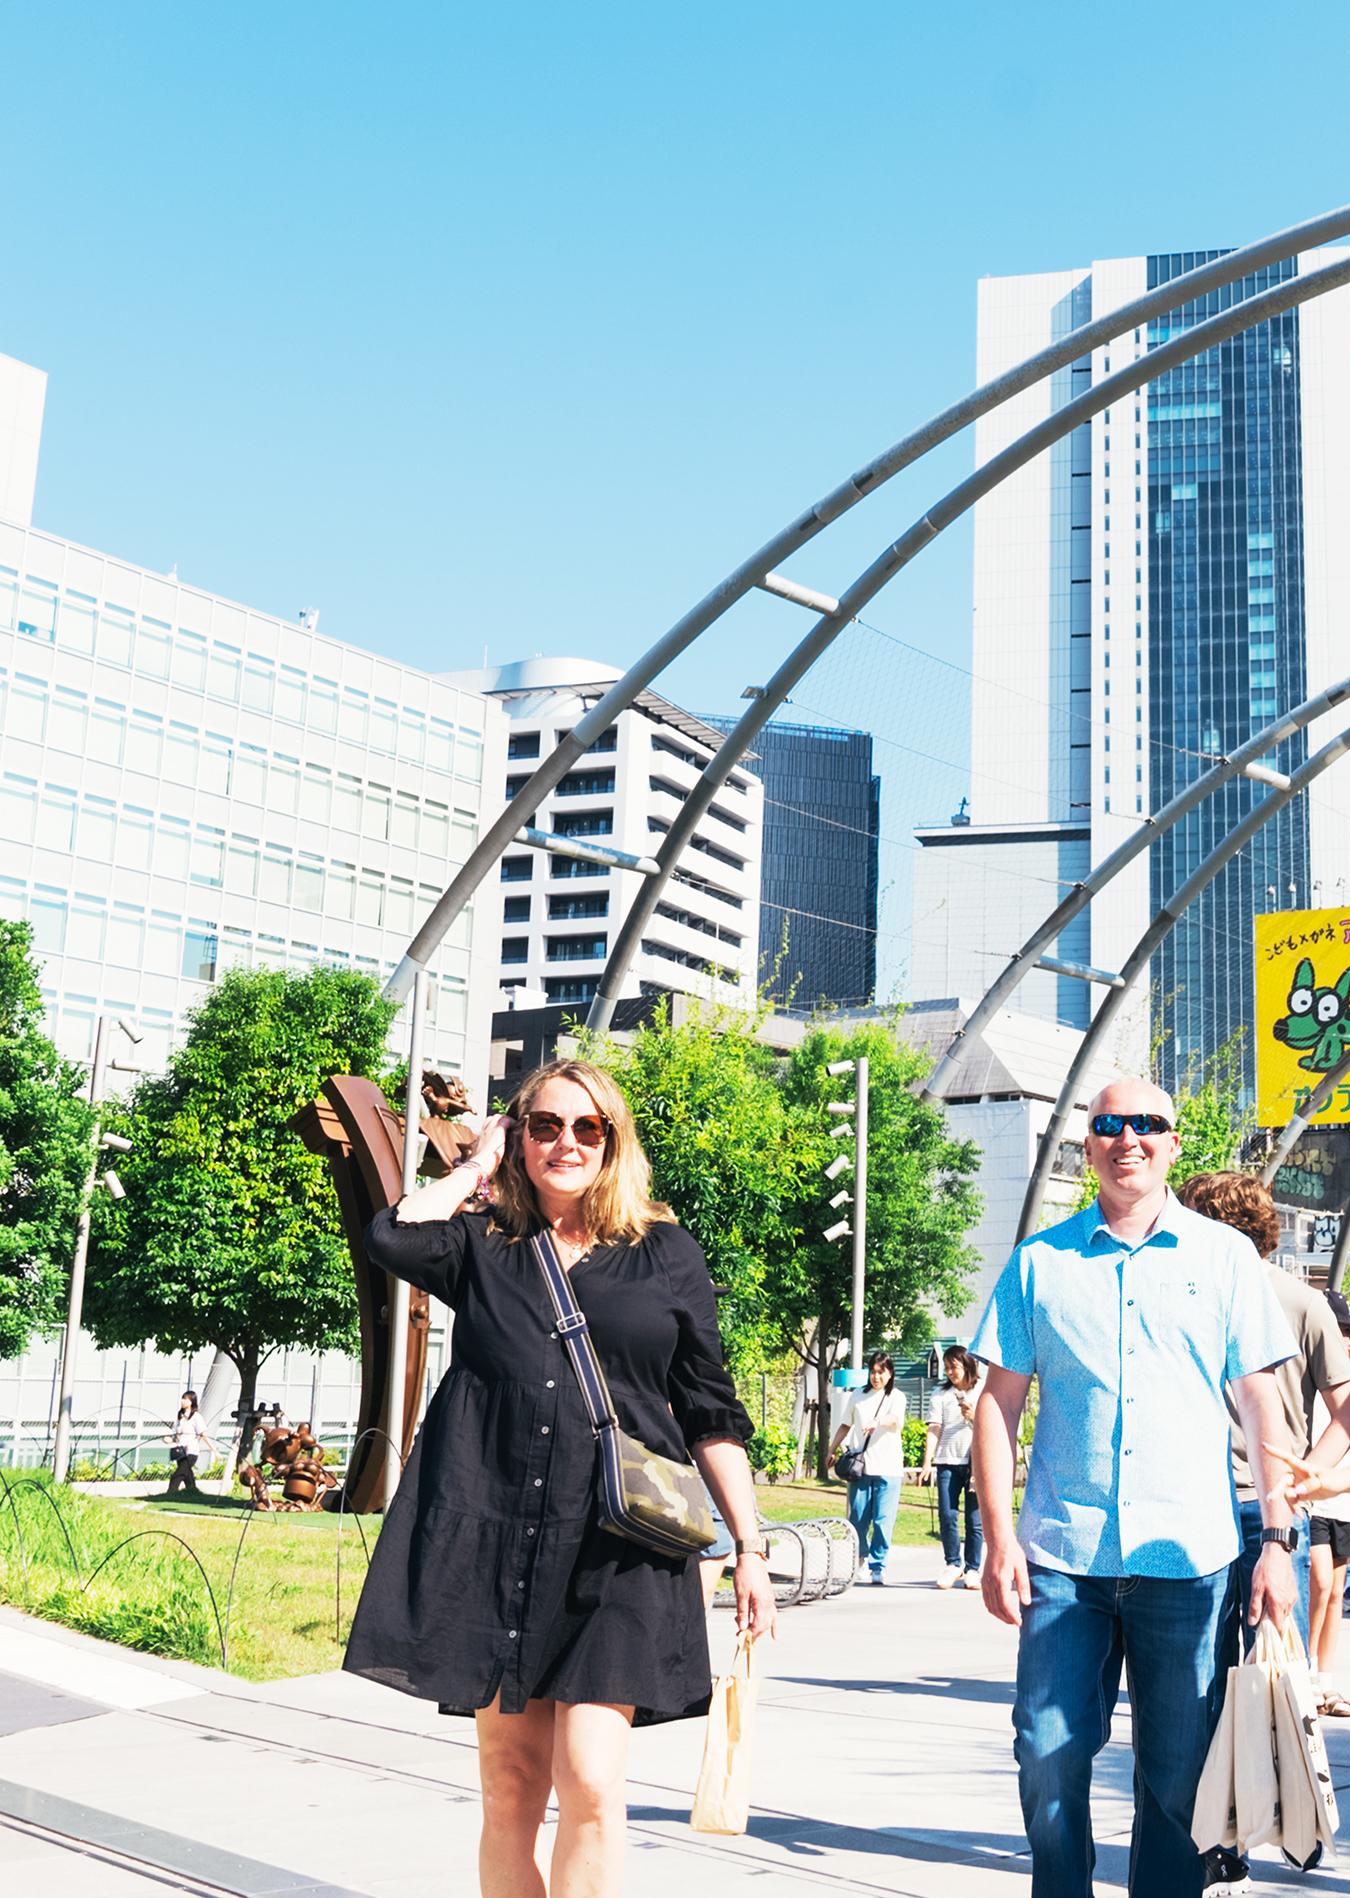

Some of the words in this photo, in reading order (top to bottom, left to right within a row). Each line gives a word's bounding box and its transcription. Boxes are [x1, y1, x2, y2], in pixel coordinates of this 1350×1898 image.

[1265, 922, 1336, 961] こどもメガネ
